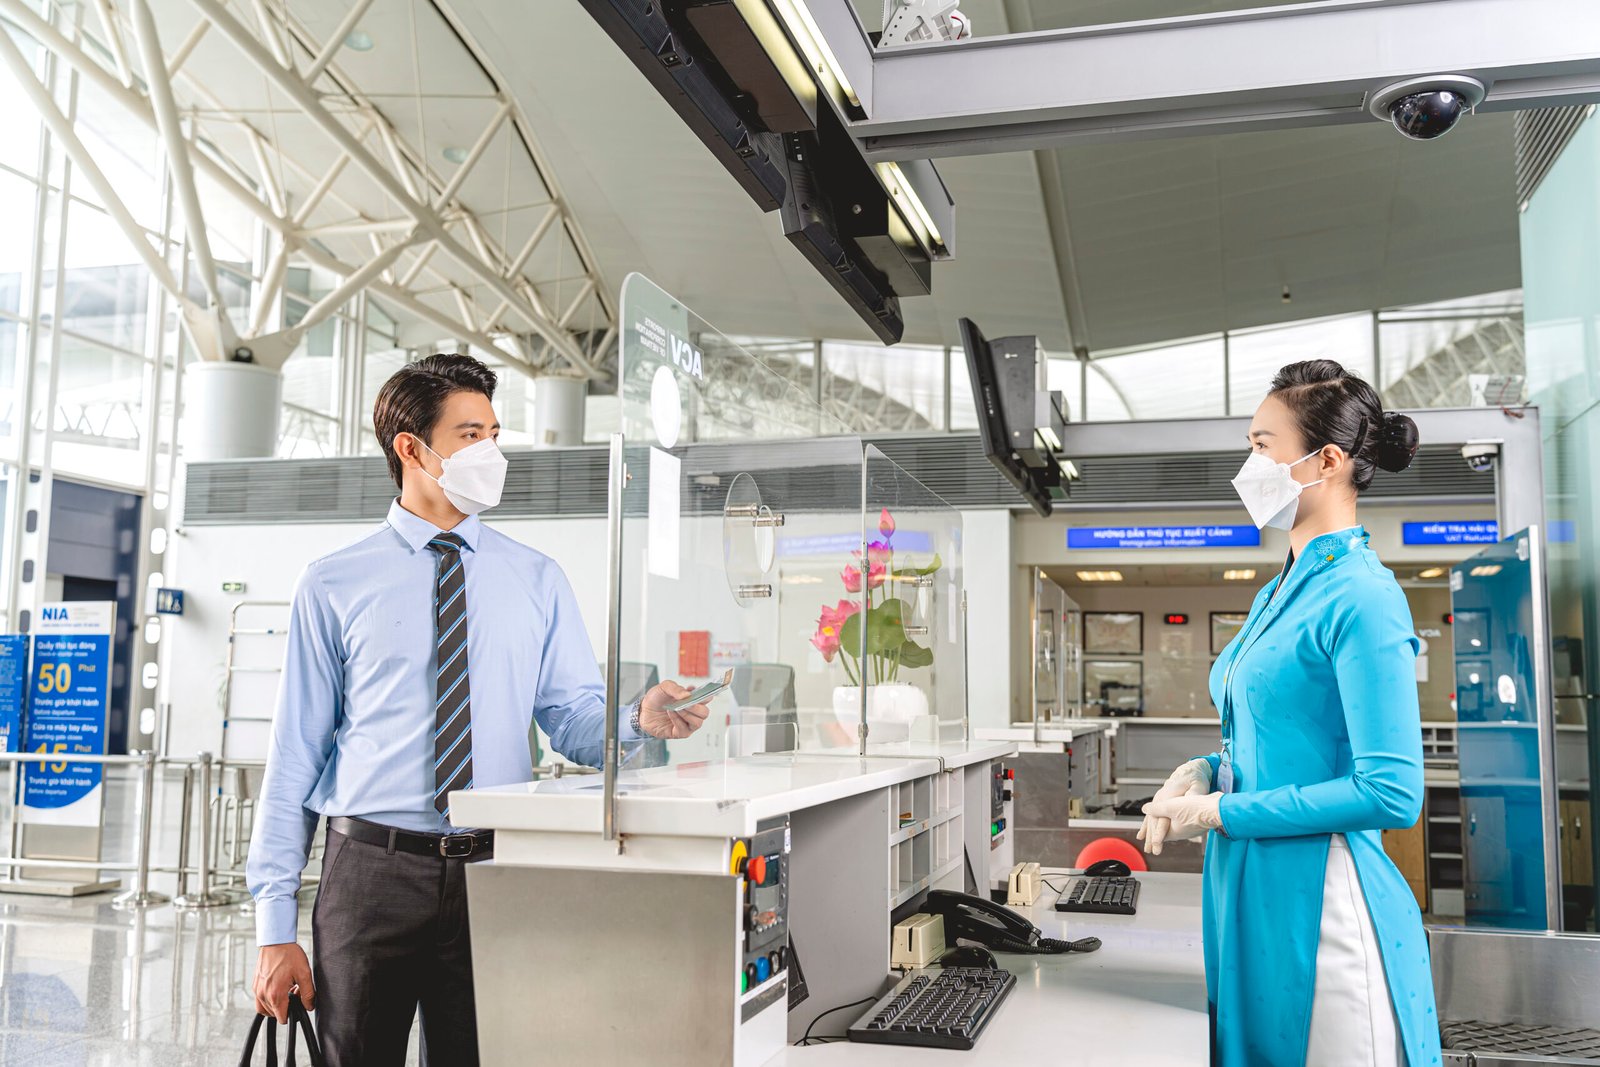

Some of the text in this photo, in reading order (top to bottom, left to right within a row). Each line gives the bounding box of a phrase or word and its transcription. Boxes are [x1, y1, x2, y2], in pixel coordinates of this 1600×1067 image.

[1486, 524, 1498, 533] QU
[42, 608, 68, 620] NIA
[38, 662, 72, 693] 50
[35, 743, 67, 773] 15
